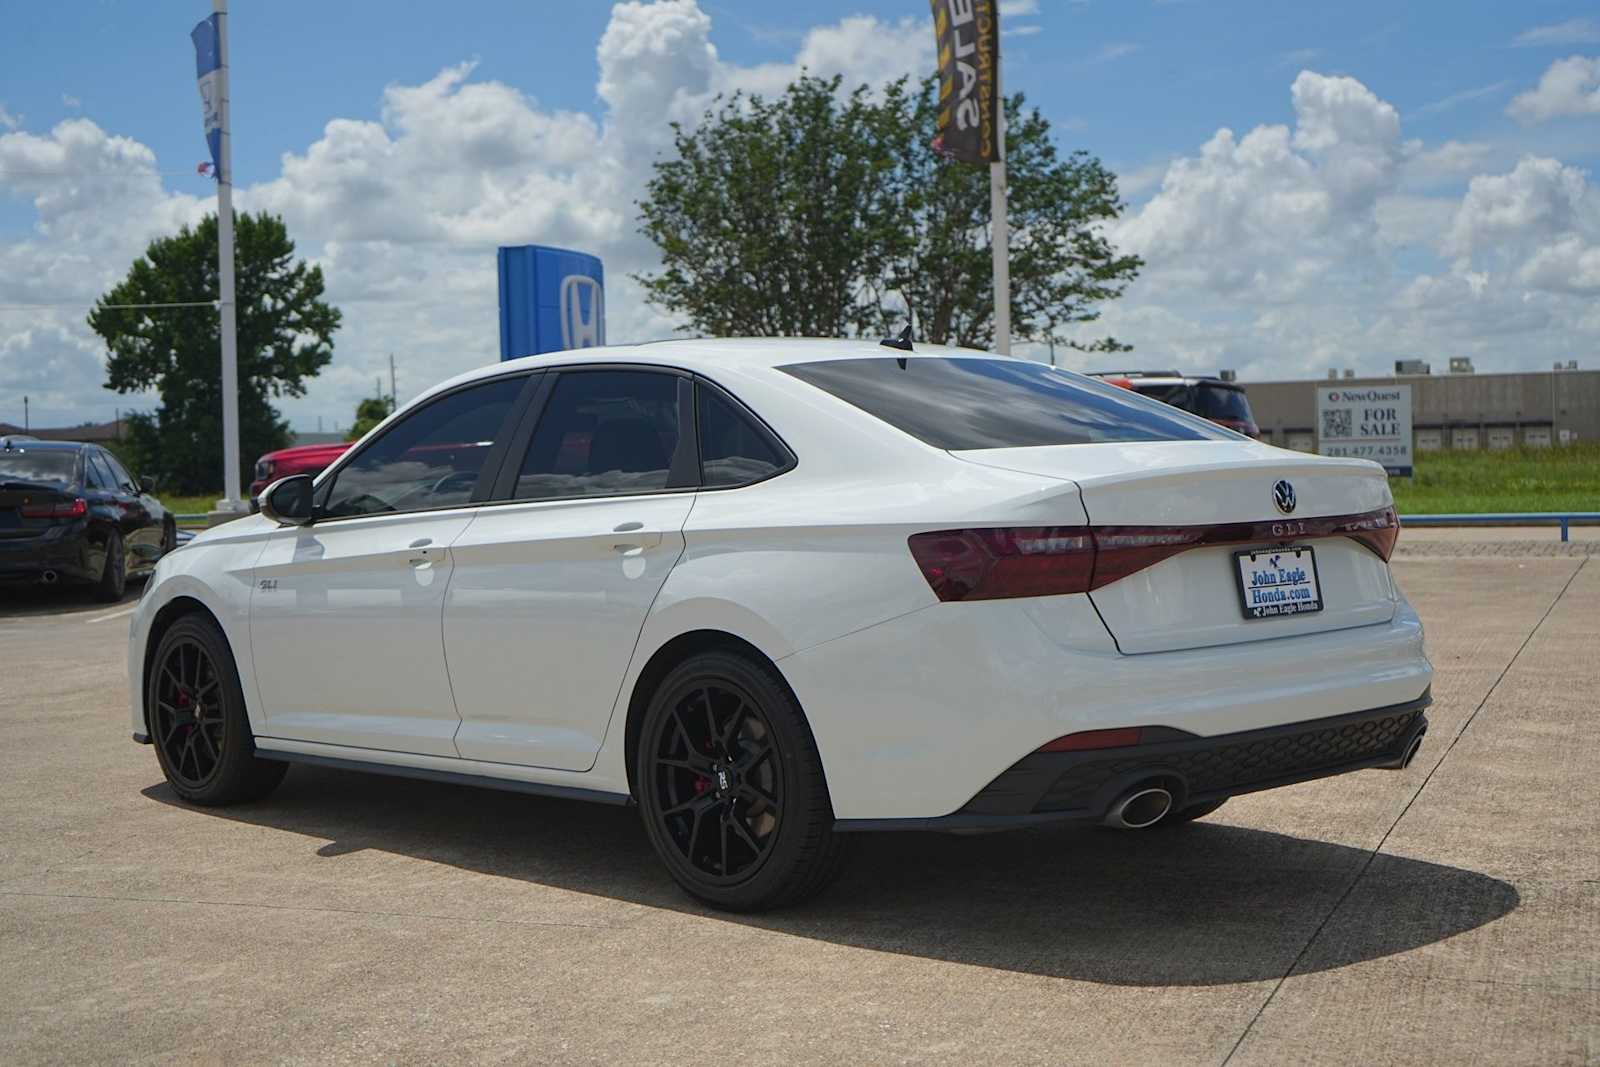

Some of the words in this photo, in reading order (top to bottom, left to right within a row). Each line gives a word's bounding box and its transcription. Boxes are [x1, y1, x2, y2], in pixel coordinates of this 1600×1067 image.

[1342, 391, 1400, 402] NewQuest
[1364, 408, 1396, 421] FOR
[1360, 423, 1400, 436] SALE
[1272, 523, 1306, 537] GLI
[1251, 571, 1277, 586] John
[1279, 568, 1306, 585] Eagle
[1252, 587, 1311, 604] Honda.com
[1263, 606, 1279, 617] John
[1280, 604, 1297, 615] Eagle
[1298, 601, 1318, 611] Honda
